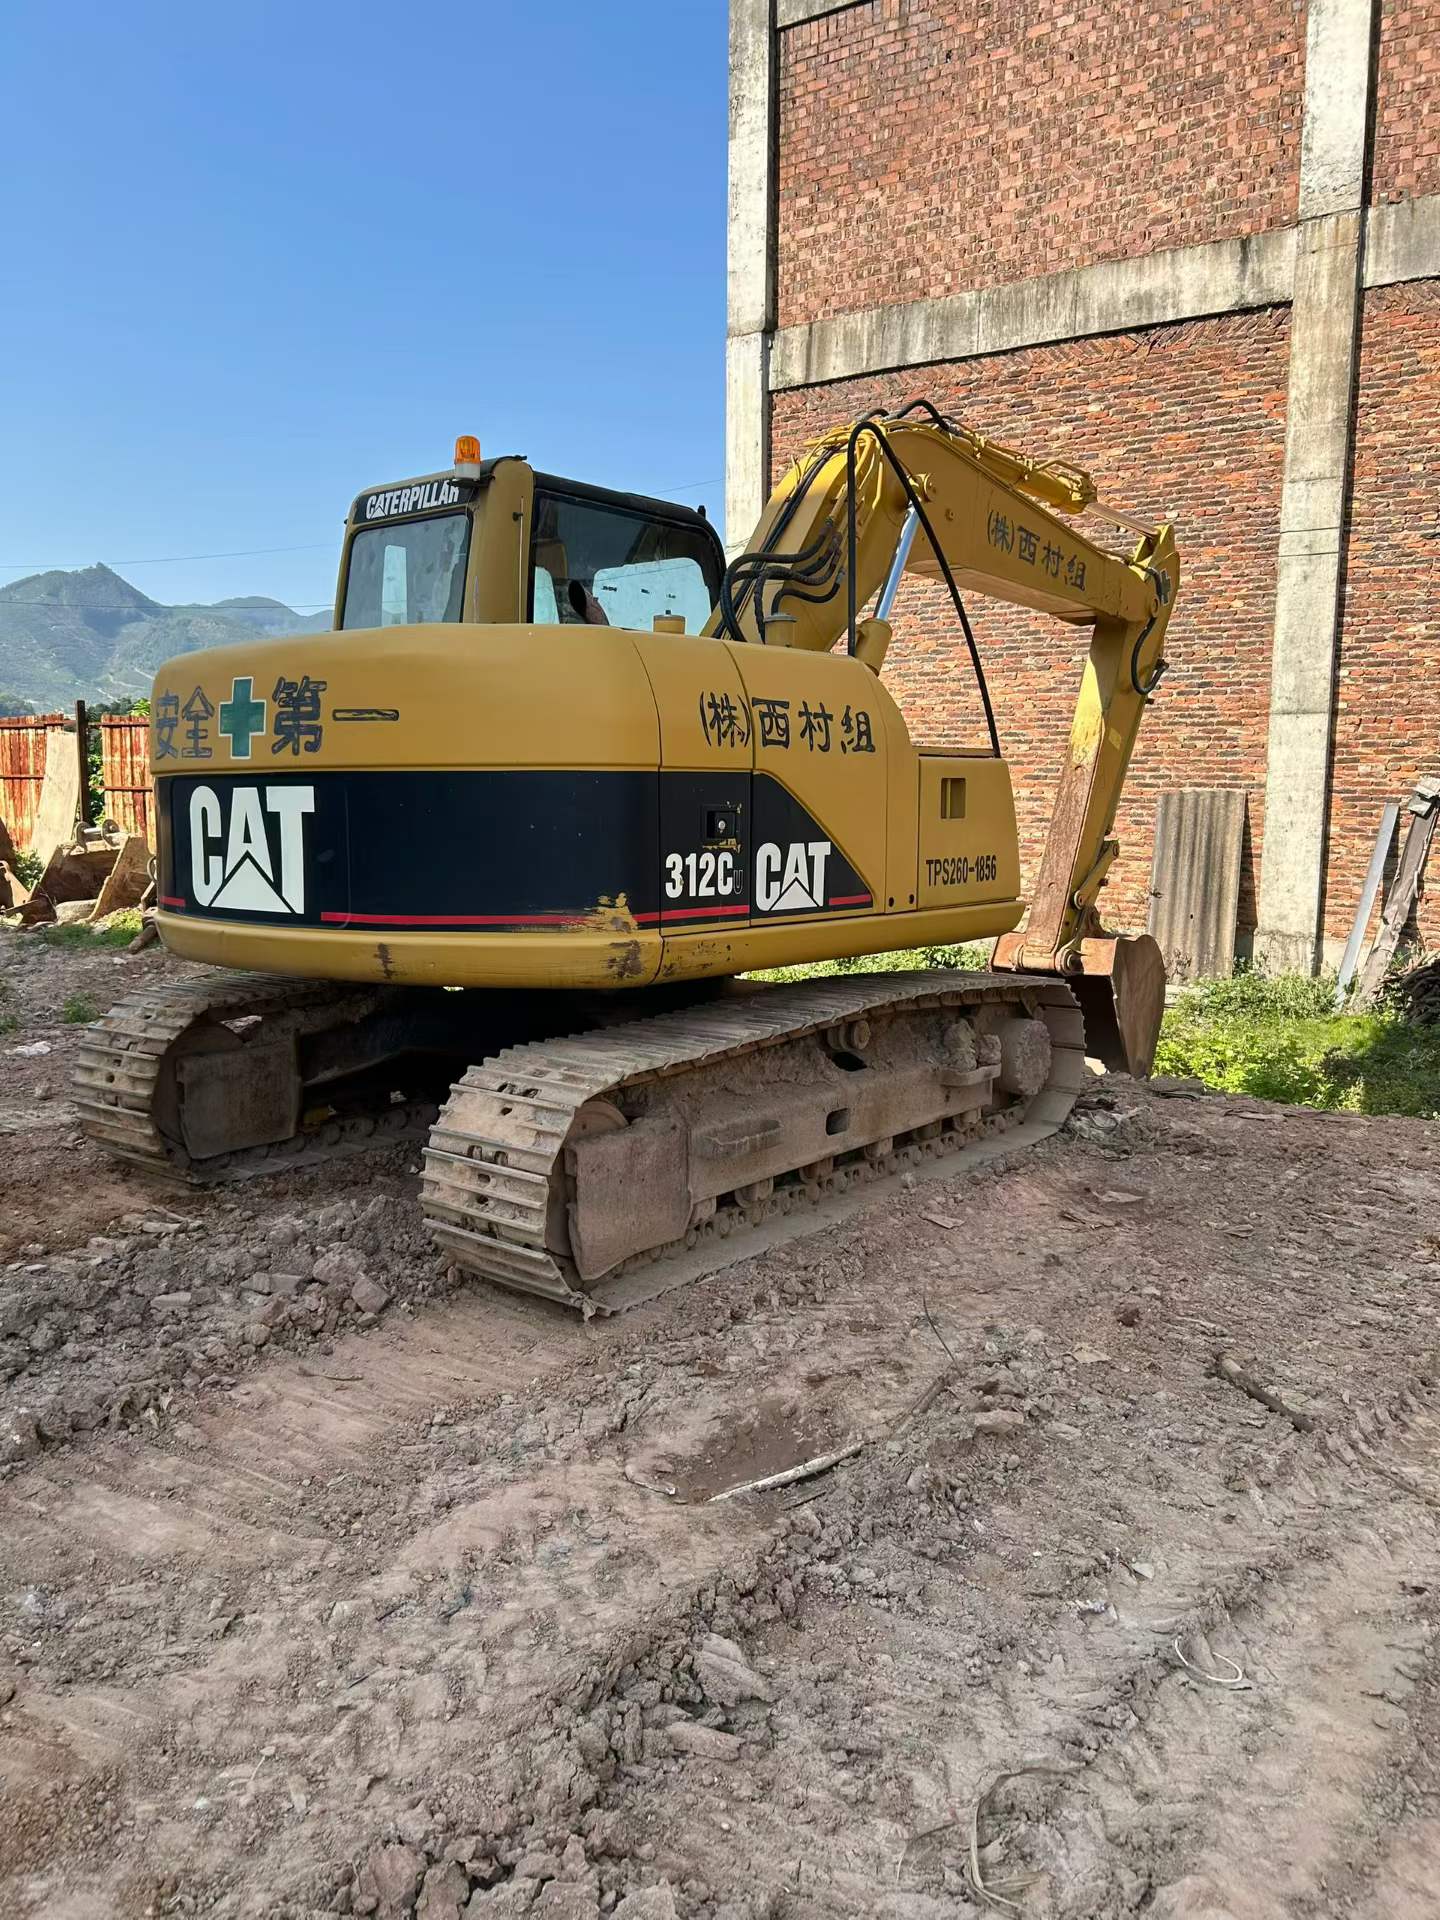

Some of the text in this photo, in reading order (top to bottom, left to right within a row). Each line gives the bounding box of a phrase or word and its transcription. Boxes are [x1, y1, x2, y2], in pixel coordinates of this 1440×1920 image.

[190, 785, 315, 914] CAT
[756, 841, 831, 911] CAT
[926, 854, 997, 887] TPS260-1856
